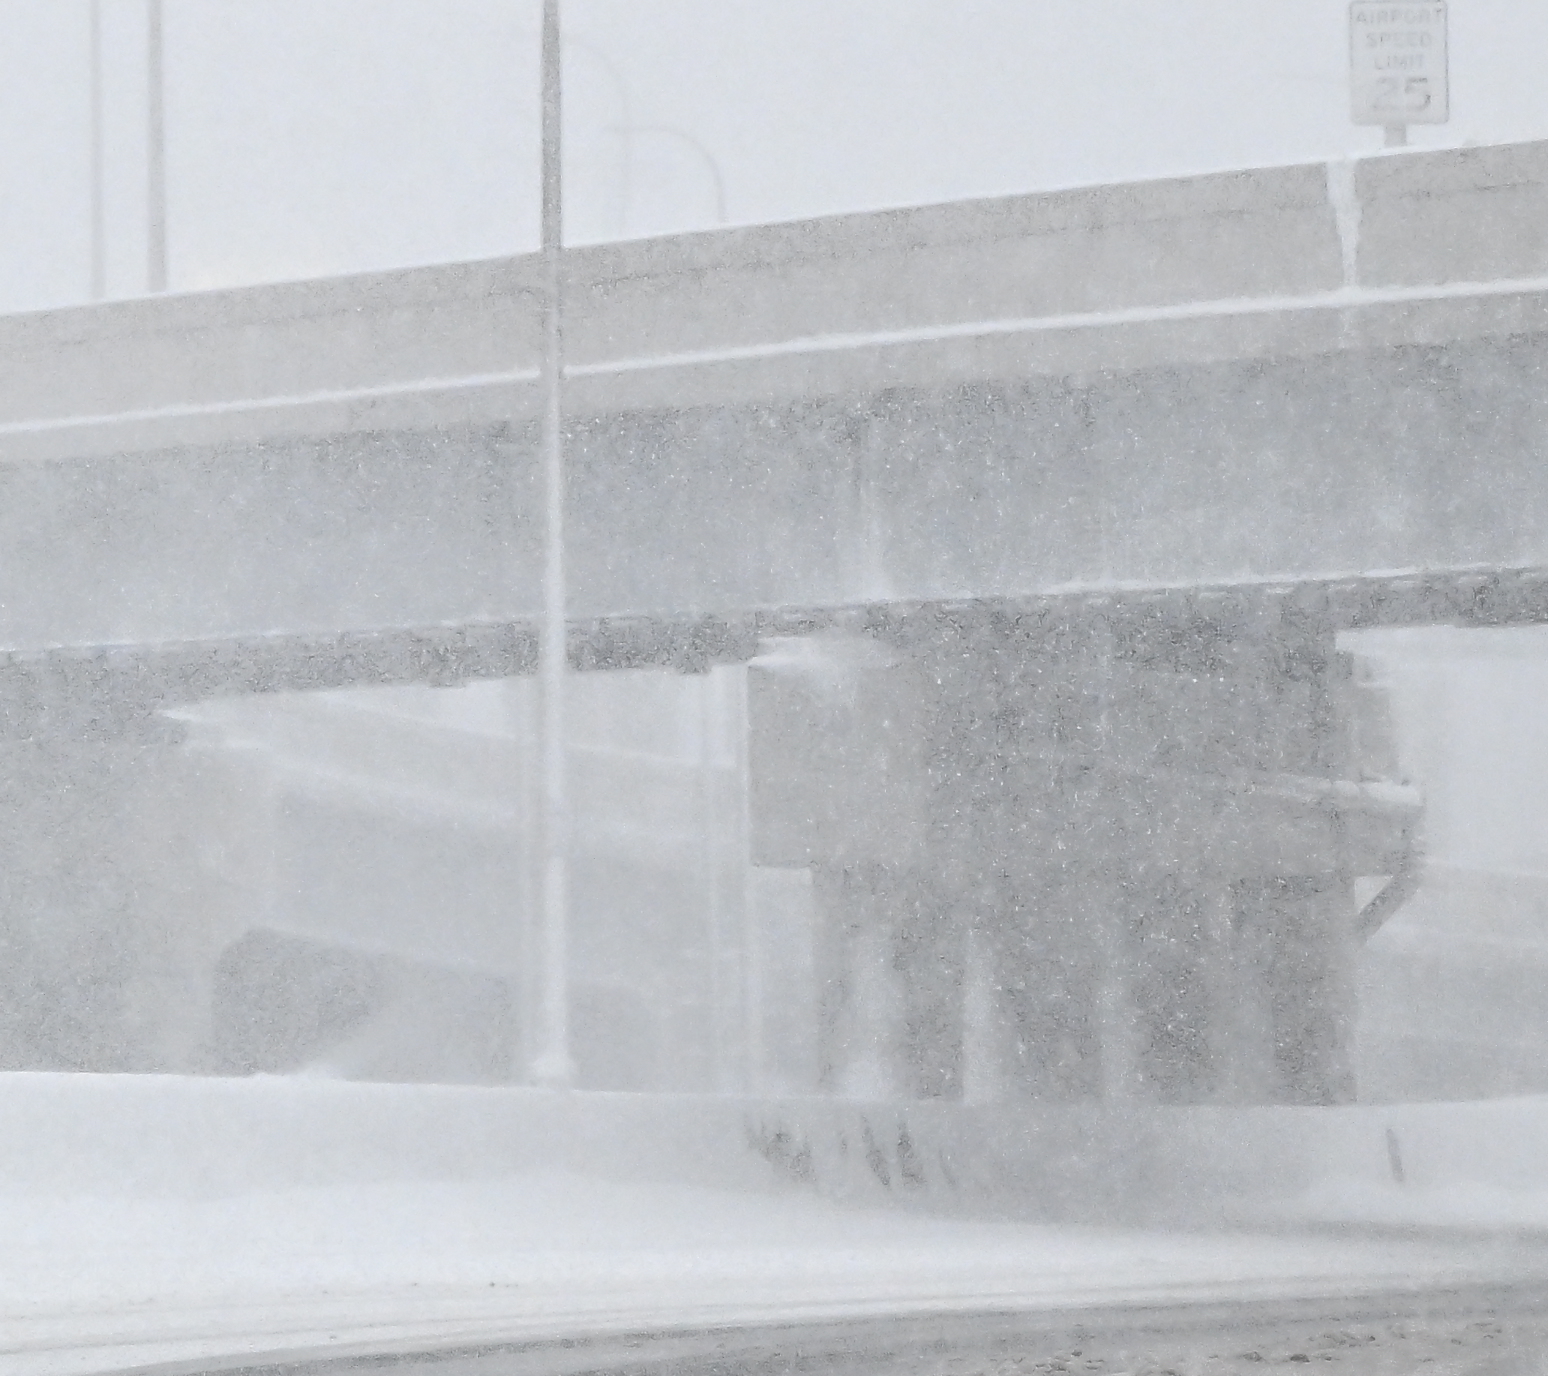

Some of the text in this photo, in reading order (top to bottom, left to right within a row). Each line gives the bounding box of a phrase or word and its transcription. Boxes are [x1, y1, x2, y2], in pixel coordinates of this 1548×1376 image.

[1356, 8, 1444, 24] AIRPORT
[1366, 32, 1431, 48] SPEED
[1374, 54, 1425, 70] LIMIT
[1370, 76, 1432, 112] 25
